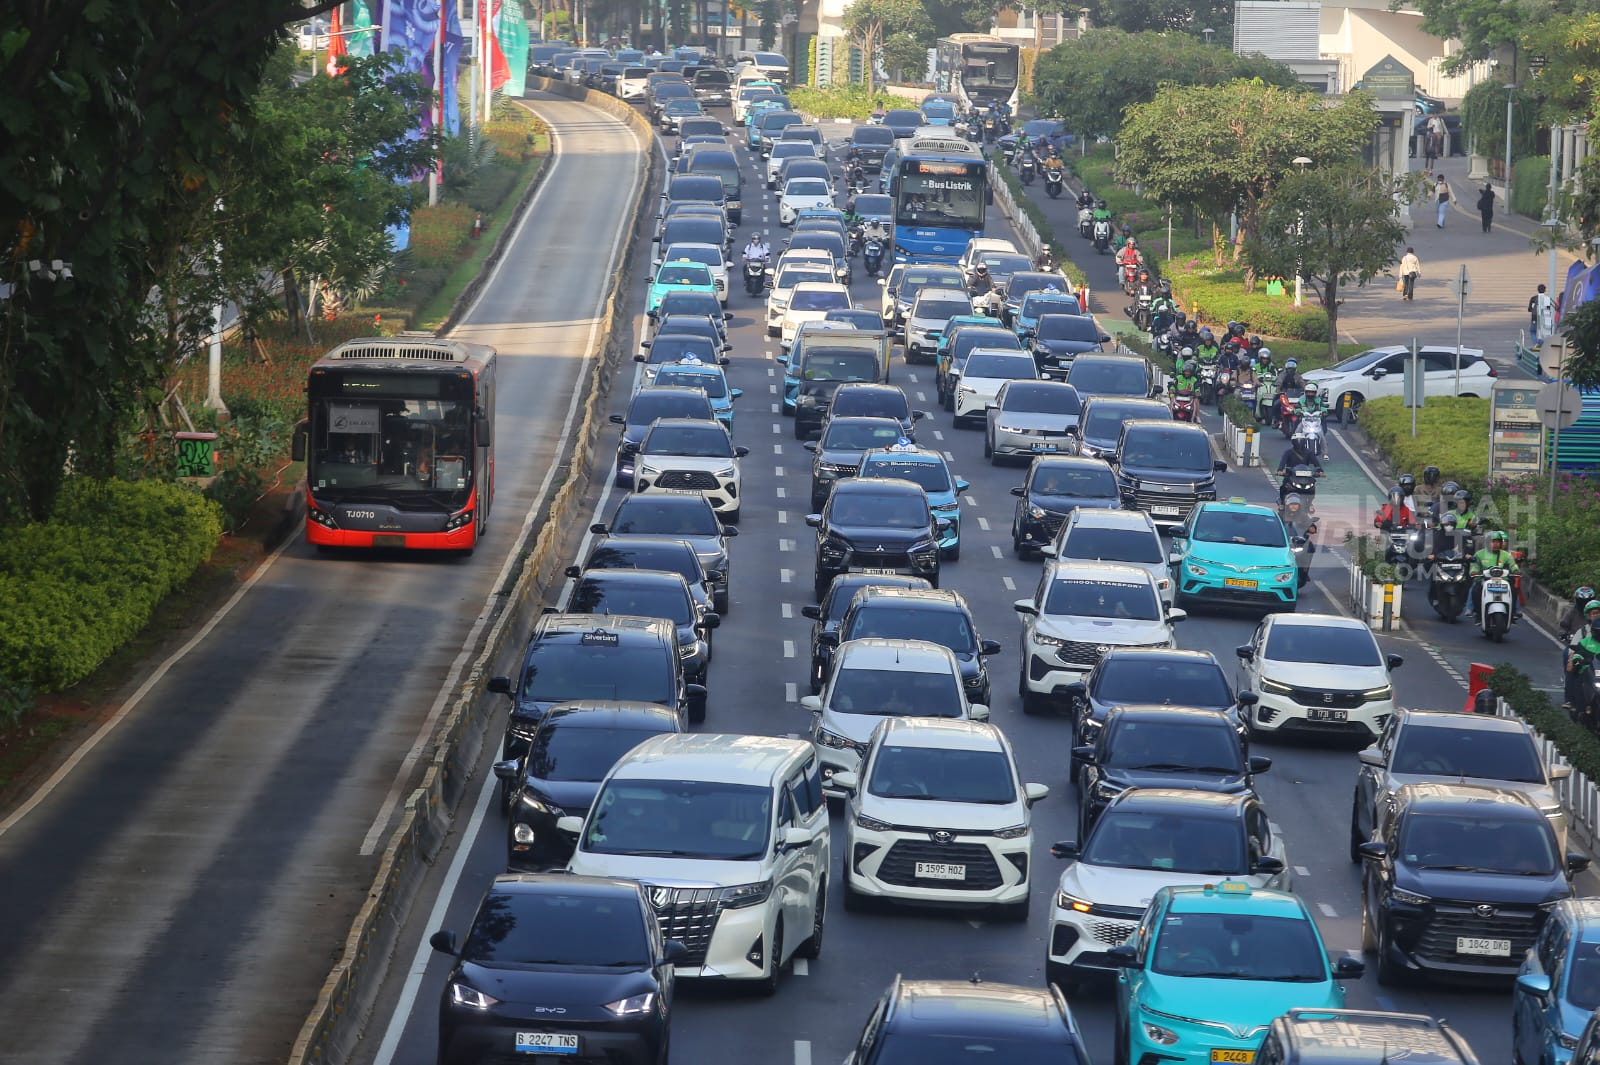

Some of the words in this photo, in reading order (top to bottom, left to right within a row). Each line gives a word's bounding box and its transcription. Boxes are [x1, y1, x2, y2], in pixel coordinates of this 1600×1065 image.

[928, 180, 945, 189] Bus
[945, 180, 972, 190] Listrik
[346, 510, 375, 519] TJ0710
[1096, 581, 1143, 589] TRANSPORT
[584, 633, 617, 642] Silverbird
[918, 864, 923, 873] B
[925, 864, 945, 874] 1595
[1458, 938, 1464, 948] B
[1468, 939, 1490, 950] 1842
[1493, 940, 1509, 951] DKB
[535, 1006, 567, 1014] BYD
[518, 1033, 524, 1045] B
[529, 1034, 553, 1046] 2247
[558, 1035, 576, 1047] TNS
[1212, 1051, 1218, 1062] B
[1223, 1051, 1248, 1063] 2448
